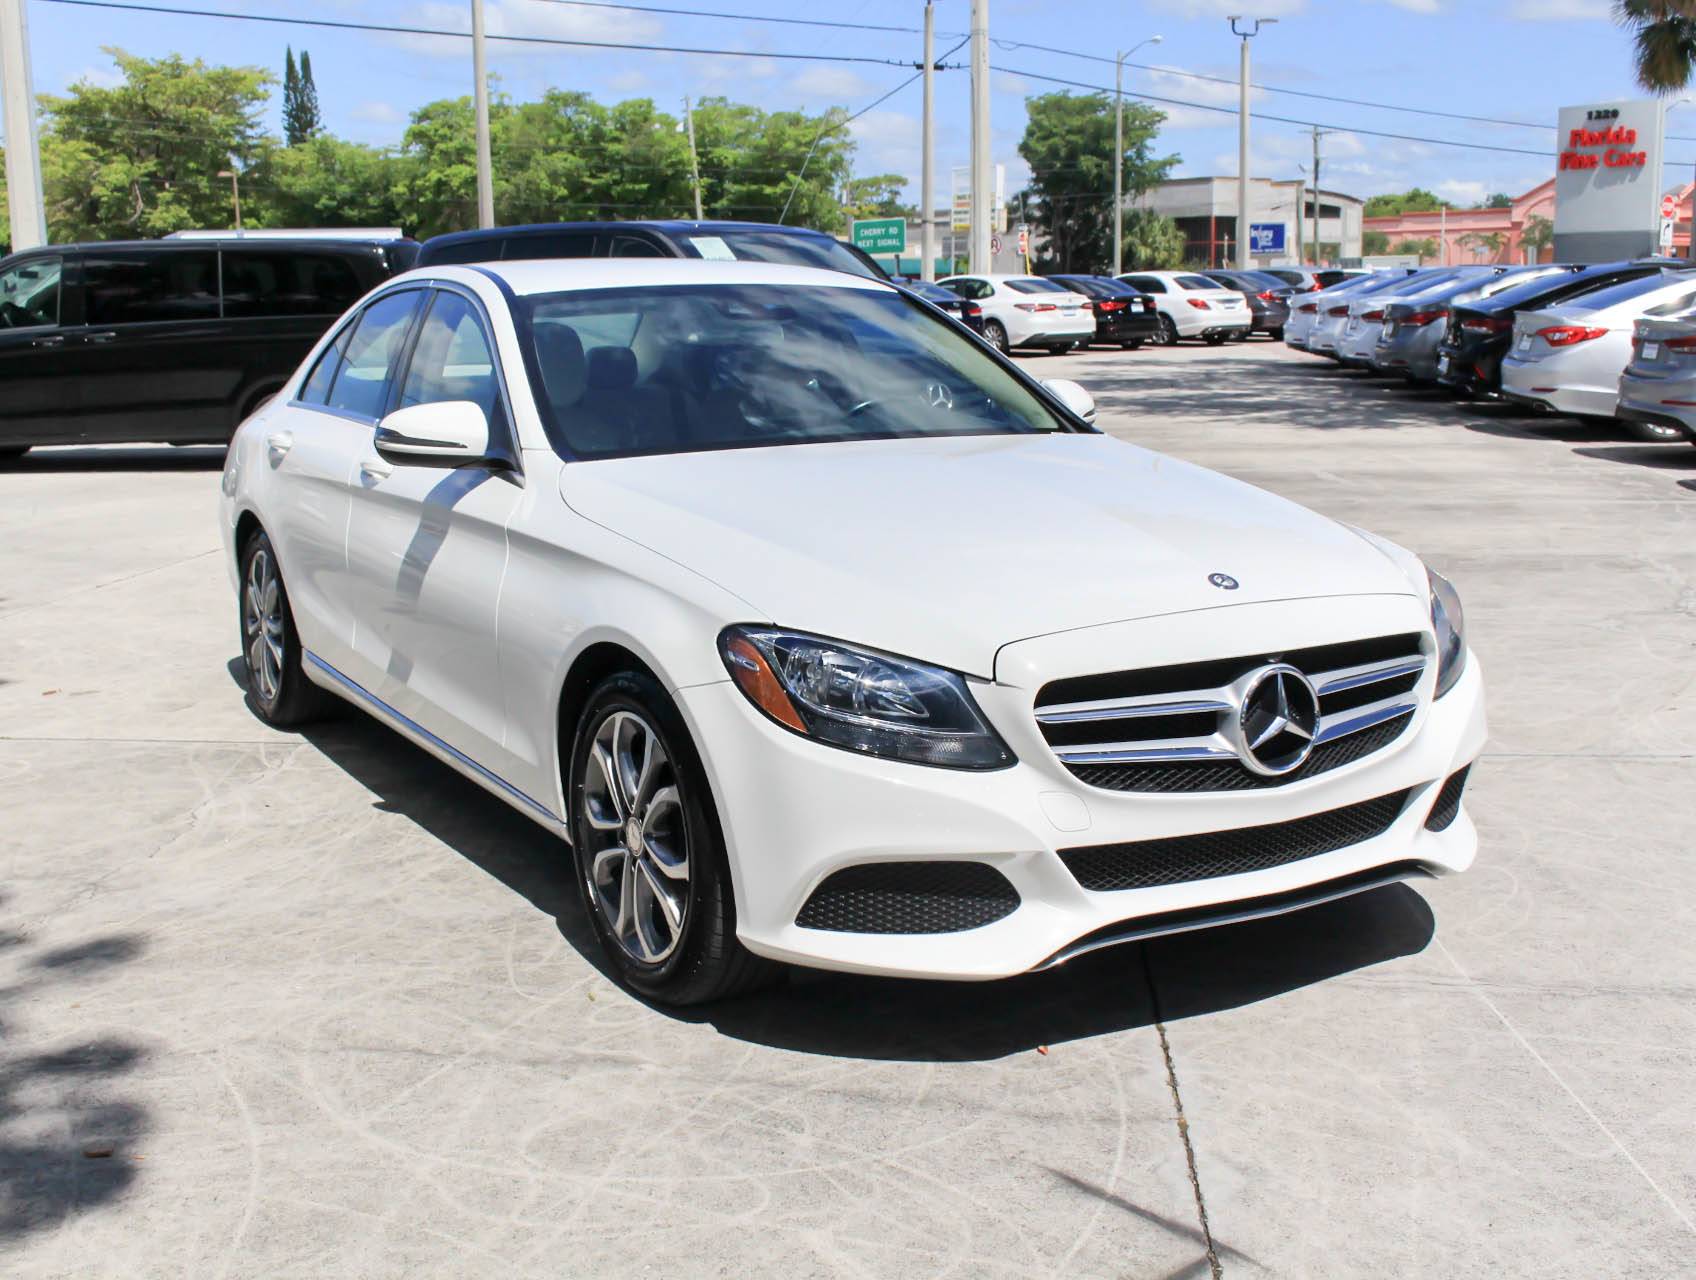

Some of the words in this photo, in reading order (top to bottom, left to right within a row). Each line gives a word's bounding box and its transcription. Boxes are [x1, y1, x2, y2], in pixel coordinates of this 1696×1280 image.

[1569, 126, 1637, 148] Florida
[1559, 151, 1599, 171] Fine
[1603, 149, 1646, 168] Cars
[860, 228, 886, 237] CHERRY
[888, 227, 898, 235] RD
[877, 238, 901, 247] SIGNAL
